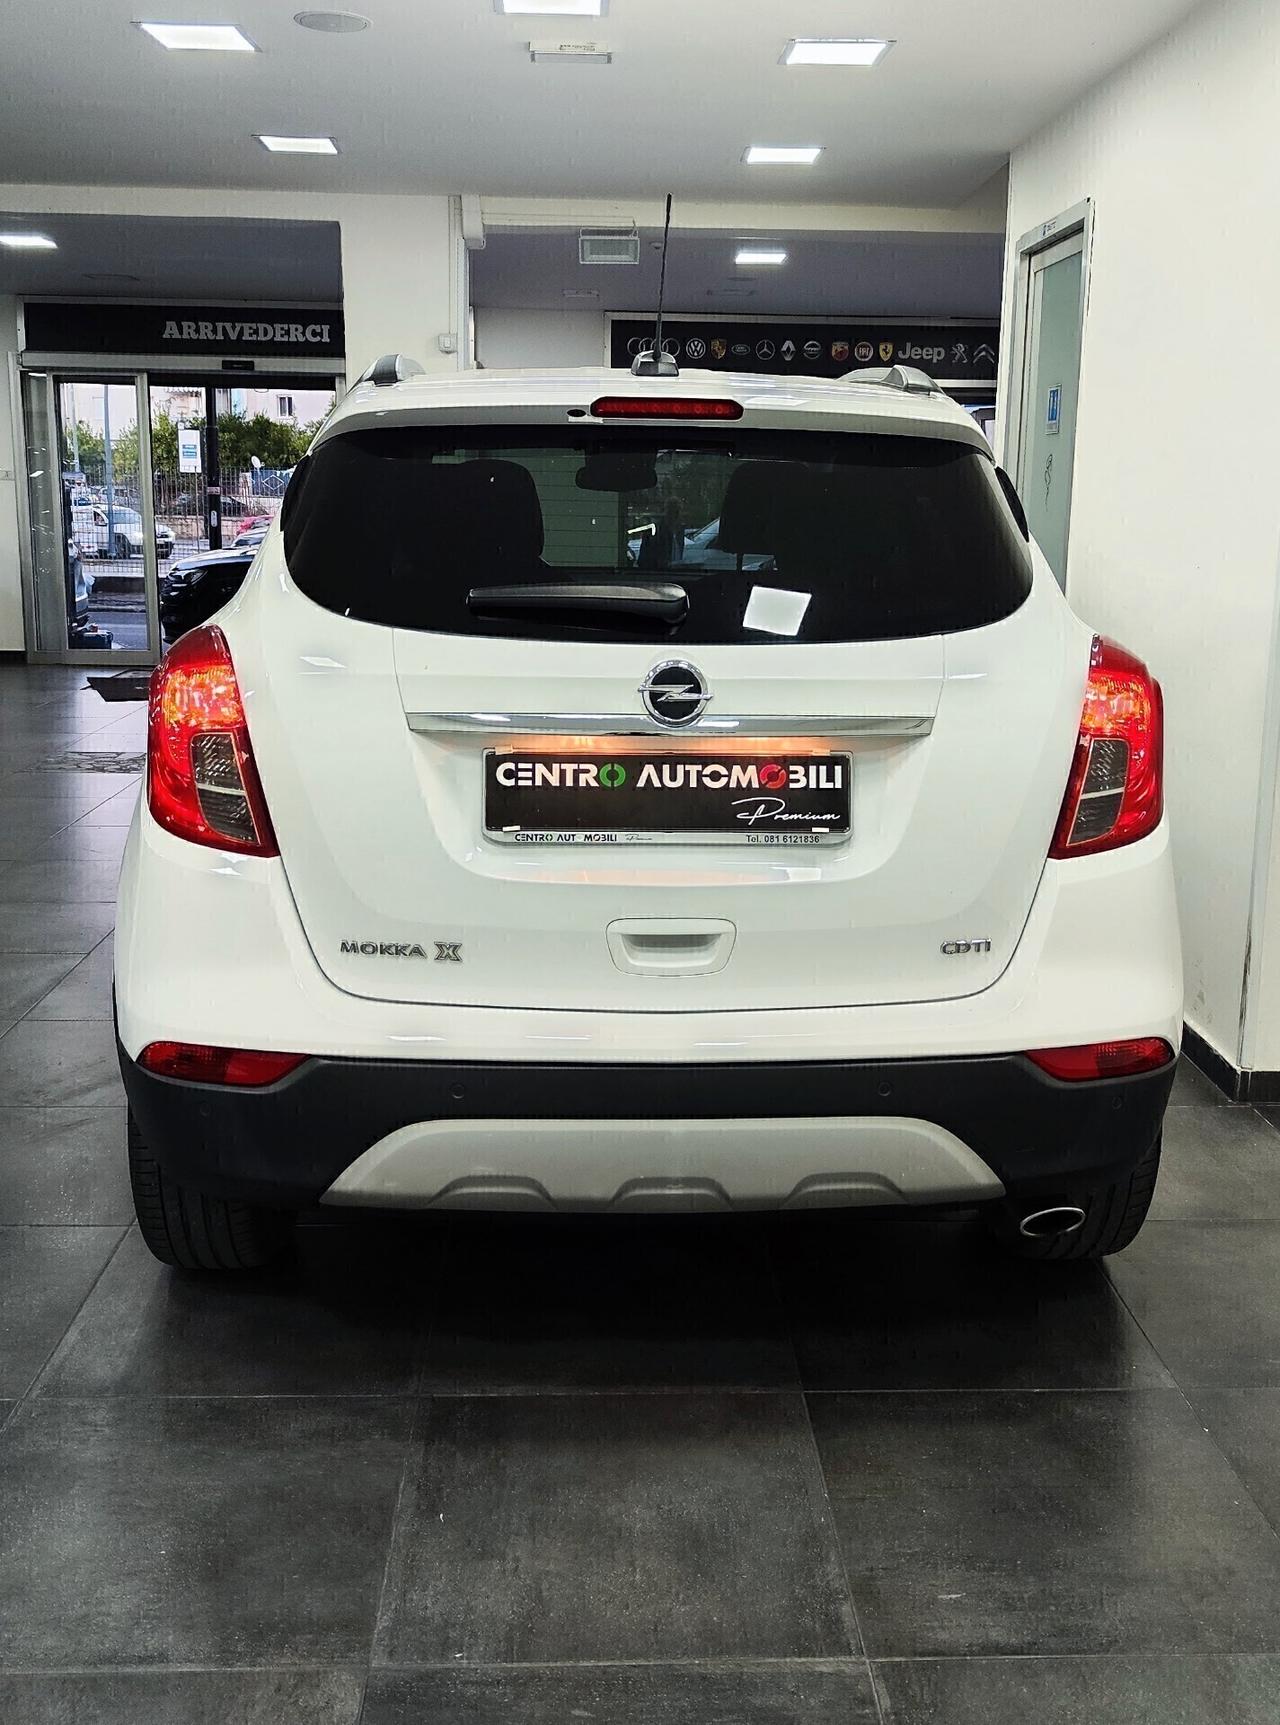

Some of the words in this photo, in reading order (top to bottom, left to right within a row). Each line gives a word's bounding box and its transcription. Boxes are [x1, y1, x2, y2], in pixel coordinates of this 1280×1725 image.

[162, 320, 331, 343] ARRIVEDERCI
[898, 342, 945, 363] Jeep
[495, 761, 626, 788] CENTRO
[636, 763, 843, 789] AUTOMOBILI
[731, 796, 841, 826] Premium
[515, 832, 554, 842] CENTRO
[556, 832, 617, 842] AUTMOBILI
[746, 834, 761, 843] Tel.
[764, 834, 780, 843] 081
[782, 834, 820, 844] 6121836
[340, 938, 428, 960] MOKKA
[433, 940, 464, 962] X
